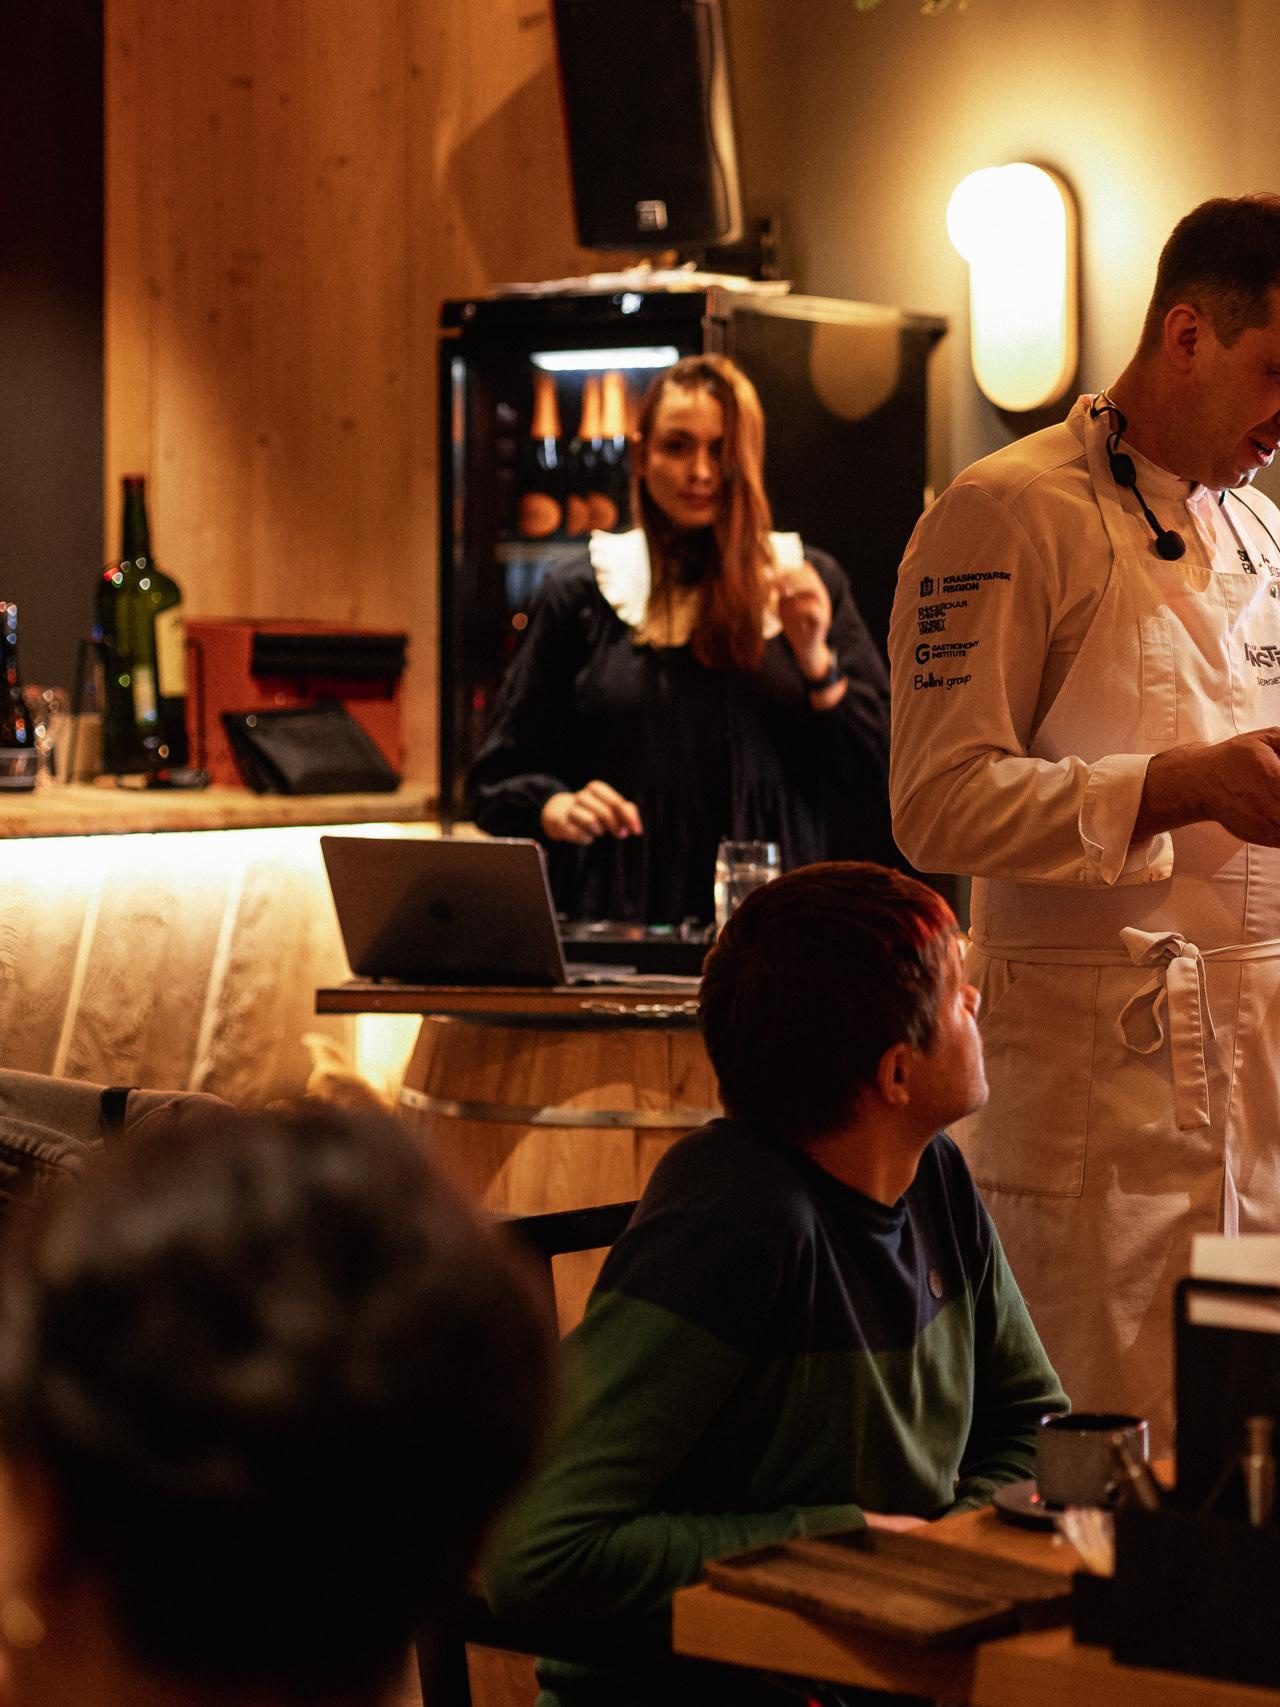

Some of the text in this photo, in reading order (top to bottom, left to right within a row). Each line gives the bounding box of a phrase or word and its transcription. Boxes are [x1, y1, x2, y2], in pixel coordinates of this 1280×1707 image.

[942, 571, 1012, 584] KRASNOYARSK
[942, 582, 980, 594] REGION
[931, 640, 980, 652] GASTRONOMY
[931, 649, 967, 659] INSTITUTE
[914, 671, 972, 691] Bellini group
